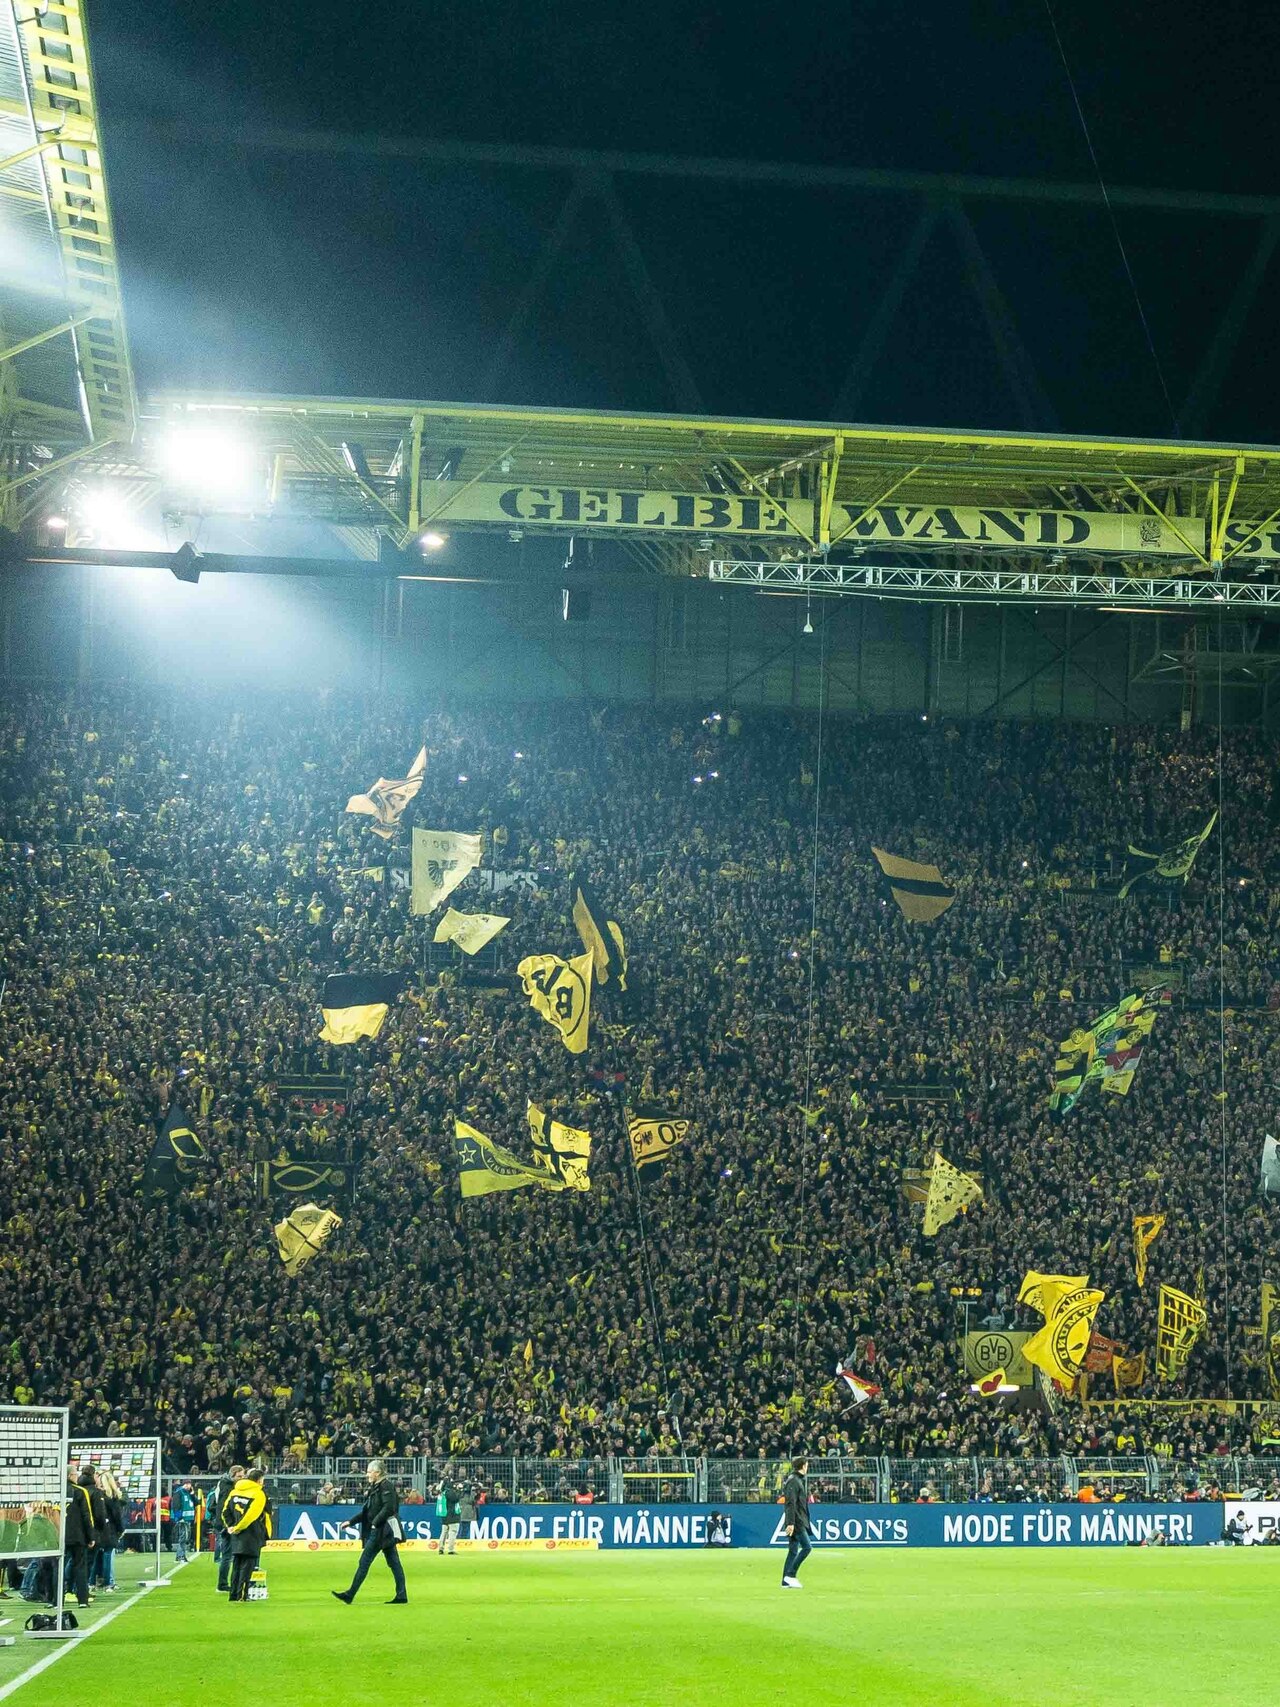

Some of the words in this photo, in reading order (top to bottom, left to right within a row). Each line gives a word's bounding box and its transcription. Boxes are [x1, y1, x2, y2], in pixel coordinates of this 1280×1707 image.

[499, 486, 787, 532] GELBE
[841, 504, 1091, 544] WAND
[980, 1338, 1007, 1361] BVB
[289, 1511, 432, 1540] ANS'S
[553, 1510, 604, 1544] FÜR
[613, 1509, 731, 1544] MÄNNE!
[770, 1511, 908, 1544] NSON'S
[943, 1514, 1014, 1542] MODE
[1023, 1509, 1072, 1542] FÜR
[1080, 1509, 1193, 1542] MÄNNER!
